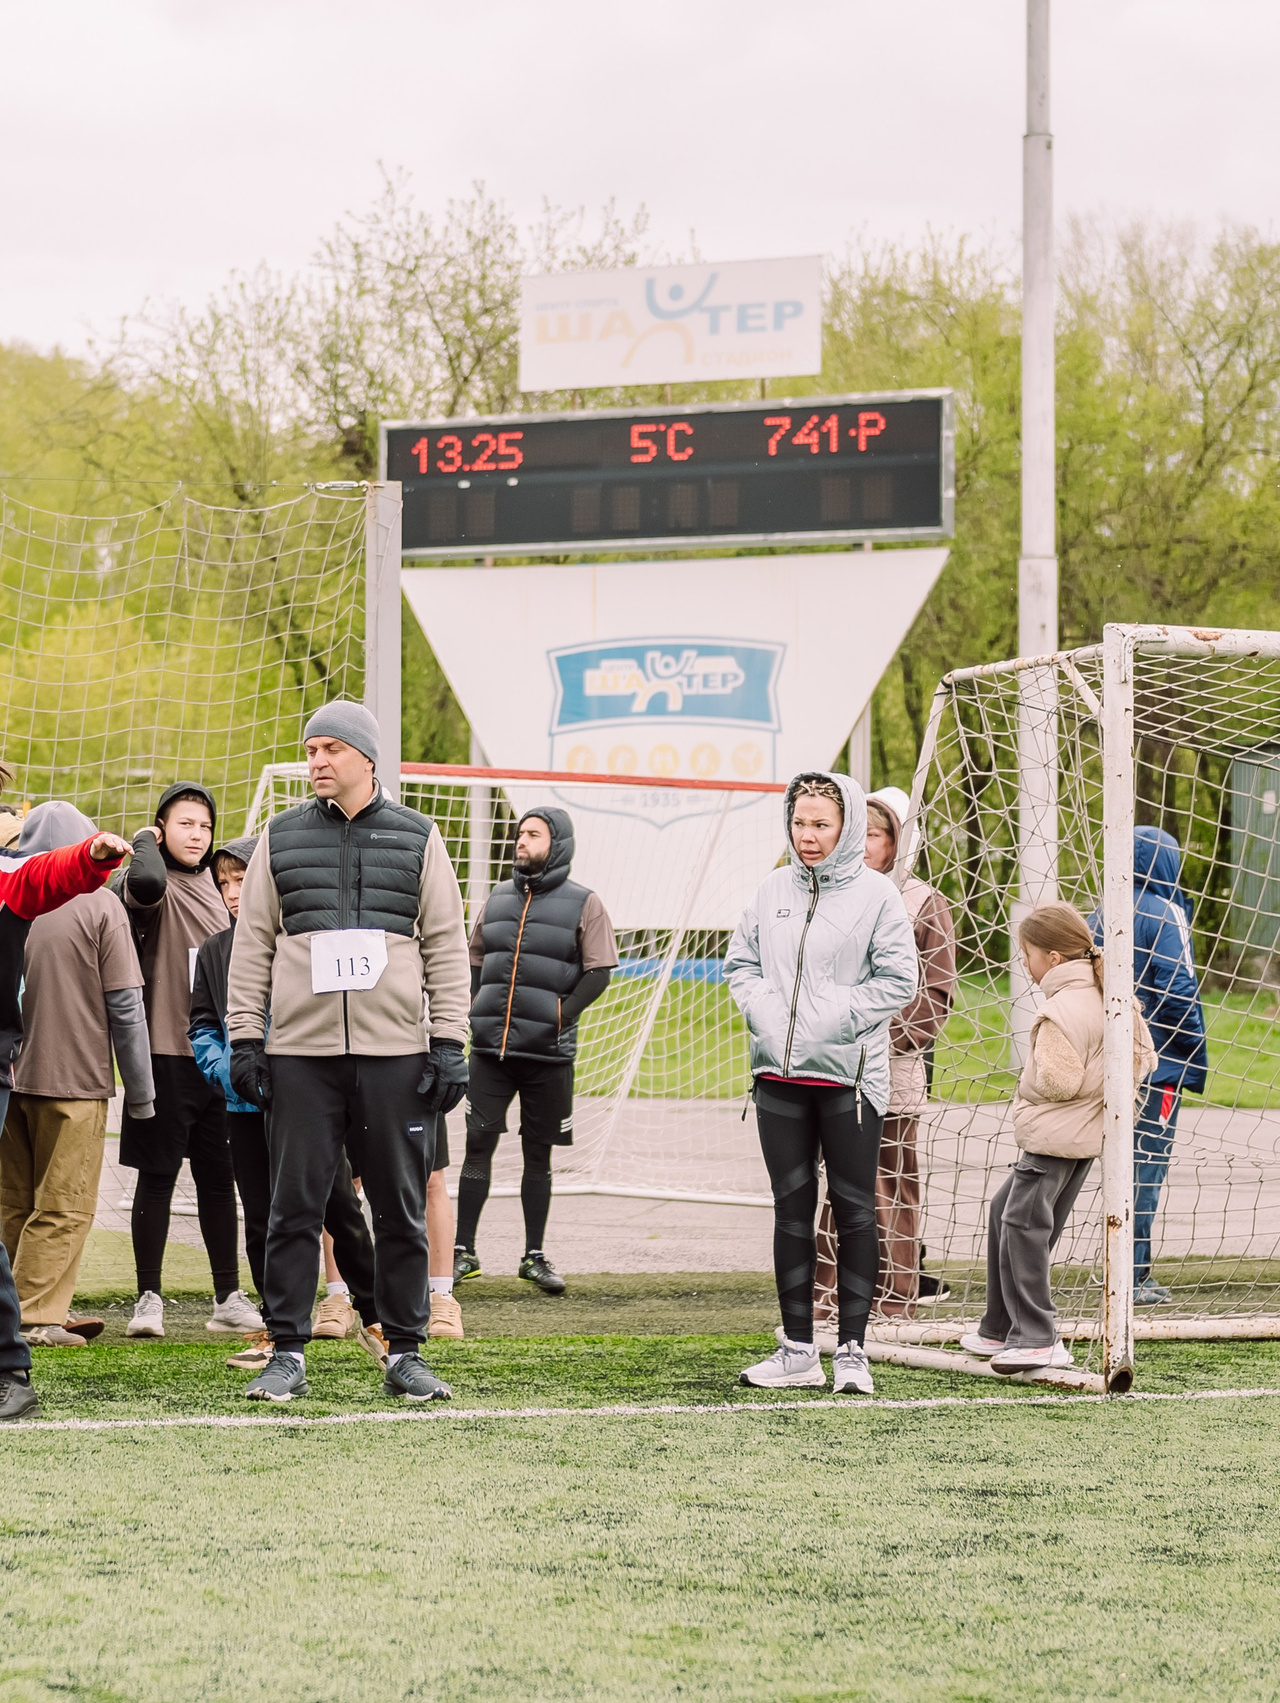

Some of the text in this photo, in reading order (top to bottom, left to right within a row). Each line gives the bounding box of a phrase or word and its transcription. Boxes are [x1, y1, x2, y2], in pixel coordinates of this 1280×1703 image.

[701, 348, 793, 368] СТАДИОН
[410, 431, 524, 474] 13.25
[335, 956, 371, 977] 113
